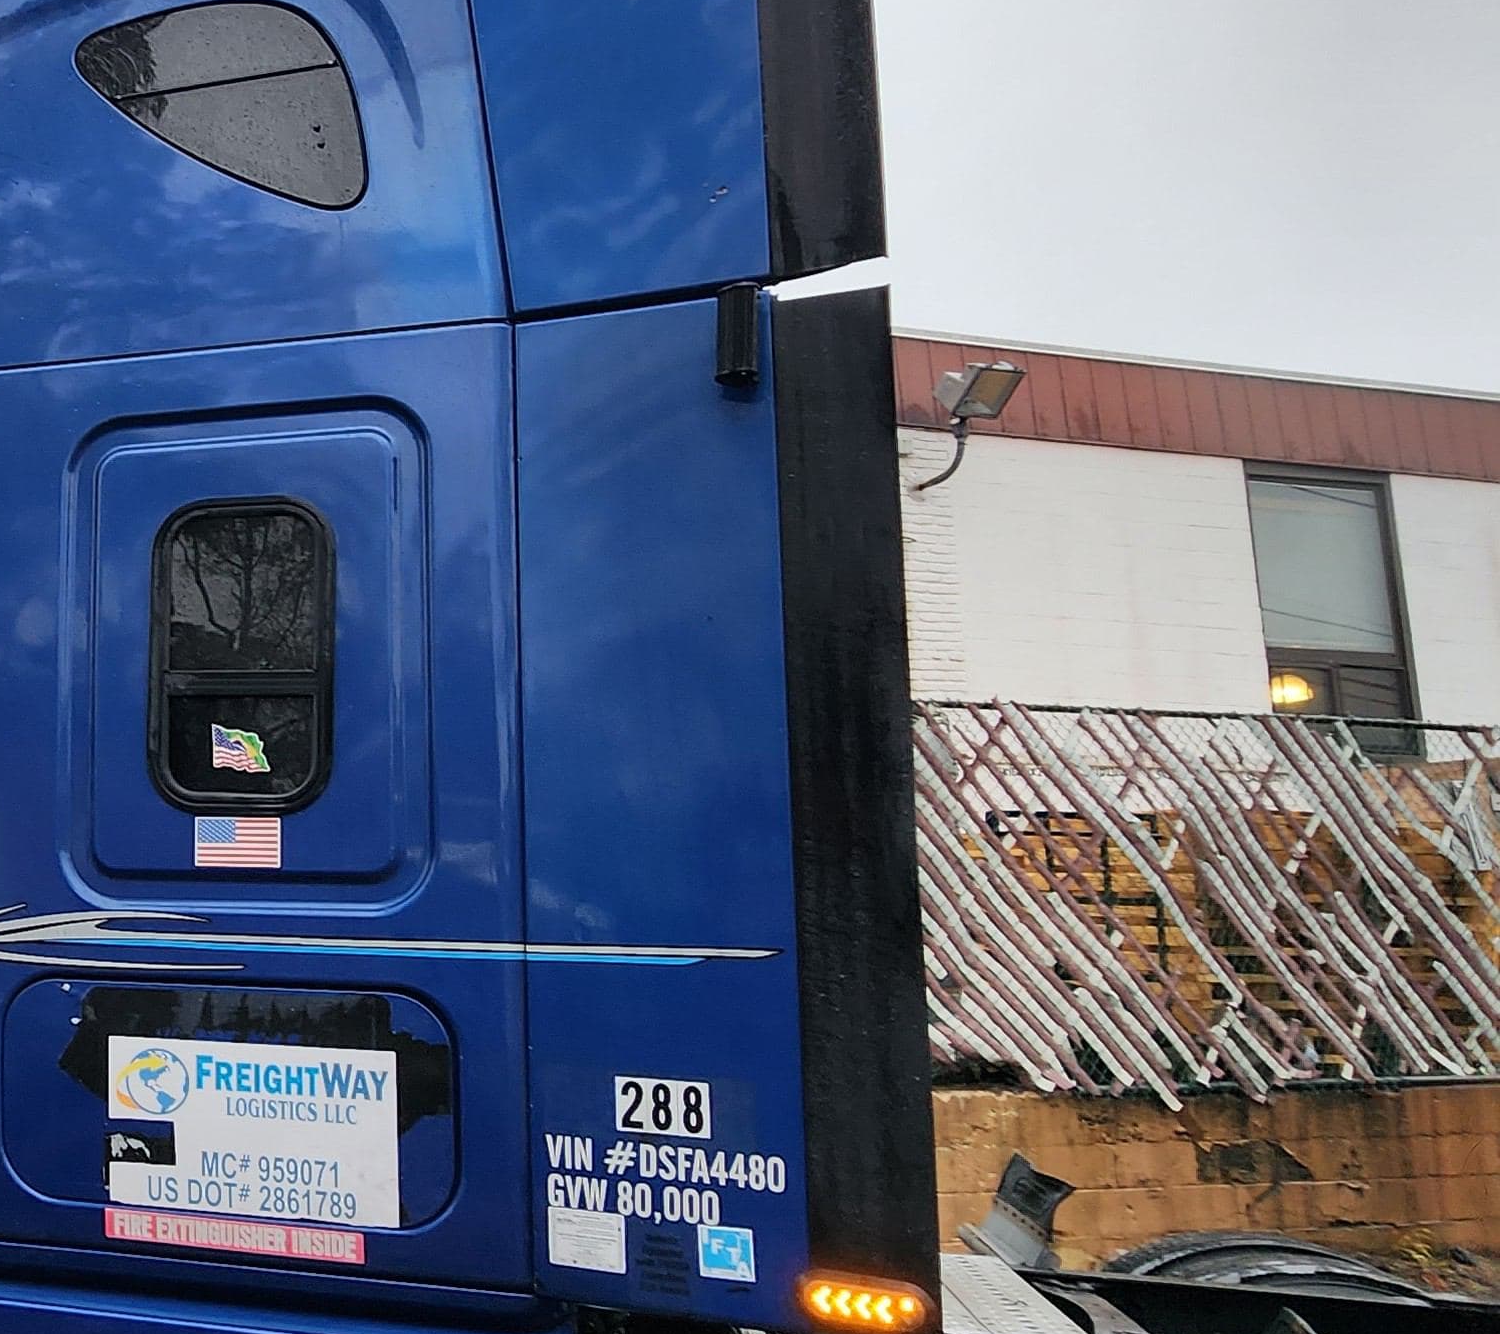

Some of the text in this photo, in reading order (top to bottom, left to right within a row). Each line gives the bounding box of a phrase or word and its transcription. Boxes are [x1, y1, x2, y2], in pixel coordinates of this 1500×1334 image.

[226, 1097, 357, 1125] LOGISTICS LLC
[620, 1081, 704, 1134] 288
[201, 1151, 340, 1188] MC# 959071
[544, 1133, 593, 1172] VIN
[148, 1175, 357, 1220] US DOT# 2861789
[547, 1173, 721, 1226] GVW 80,000
[113, 1212, 357, 1259] FIRE EXTINGUISHER INSIDE
